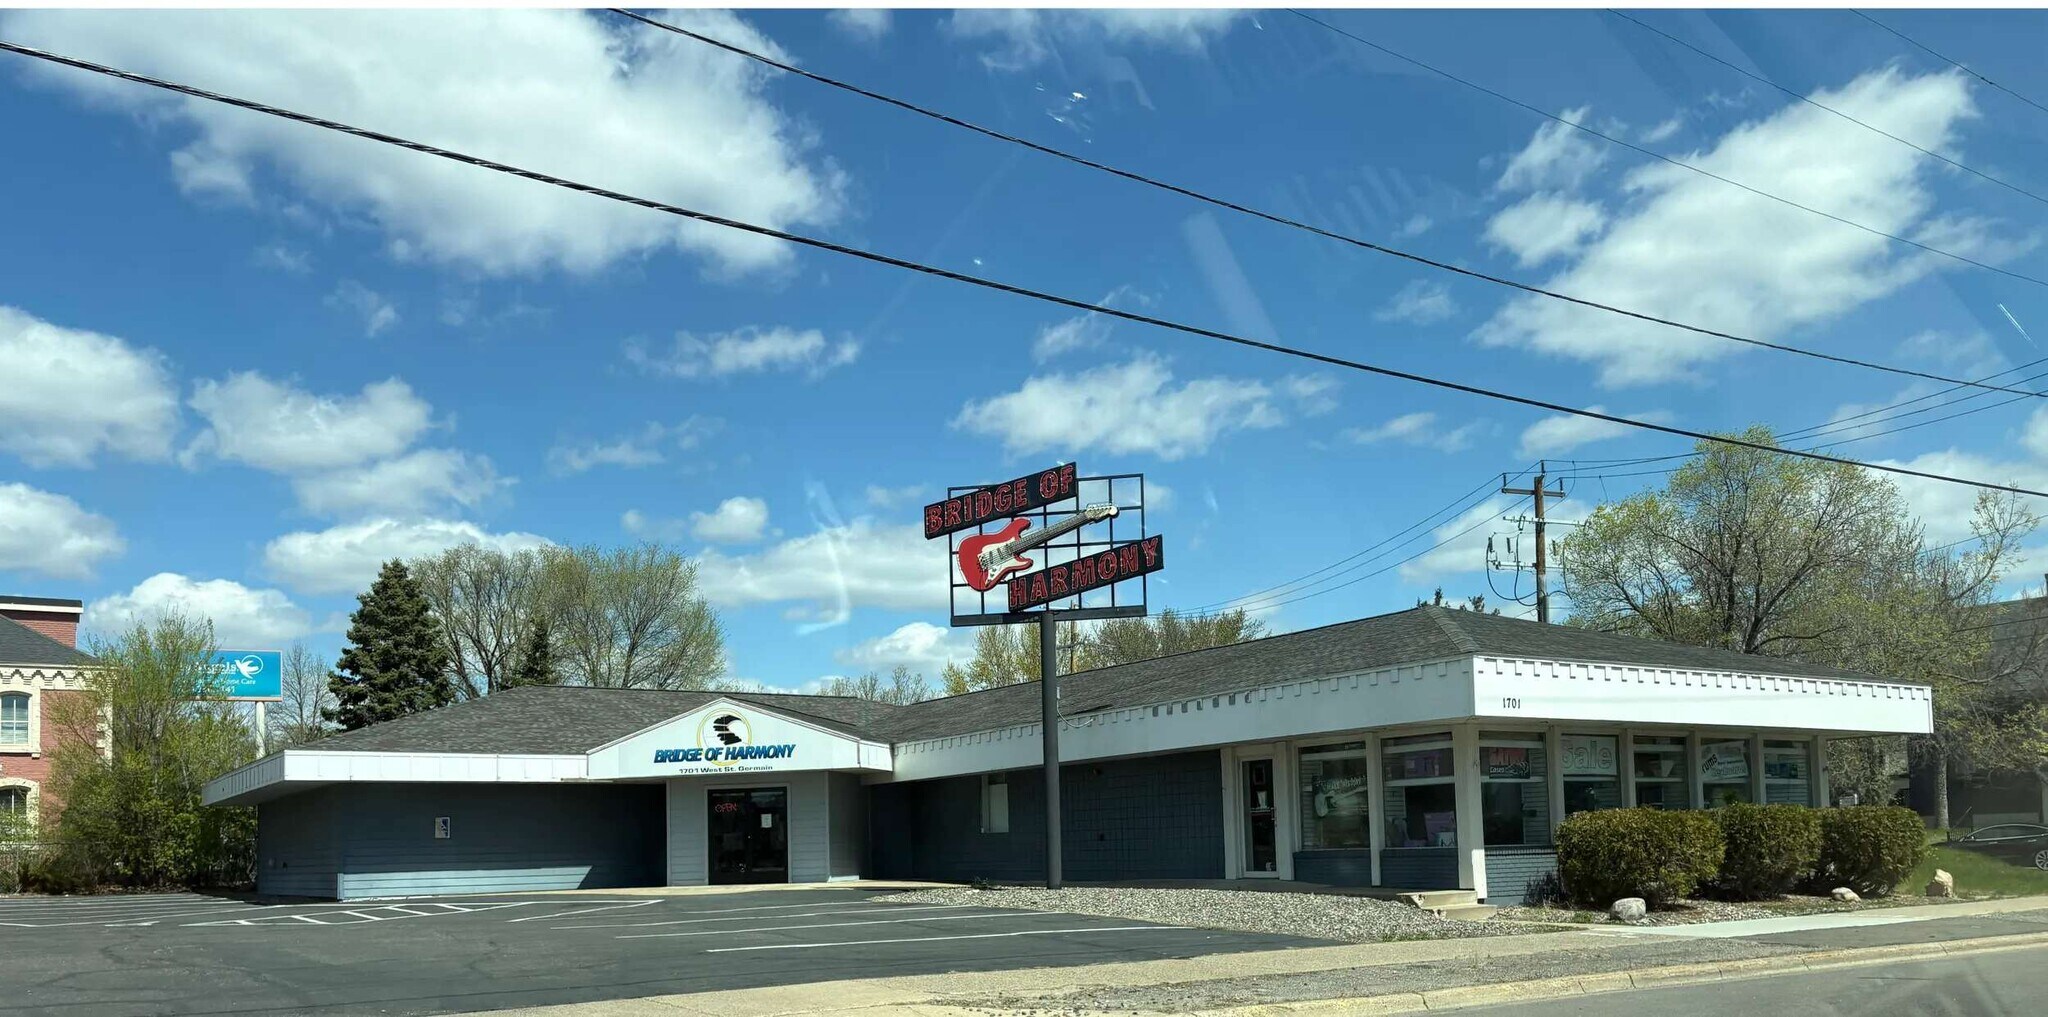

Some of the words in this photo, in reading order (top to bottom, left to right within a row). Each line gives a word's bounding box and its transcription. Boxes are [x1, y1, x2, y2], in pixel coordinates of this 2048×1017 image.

[925, 479, 1028, 534] BRIDGE
[1039, 464, 1074, 500] OF
[1009, 537, 1159, 607] HARMONY
[1503, 697, 1521, 709] 1701
[654, 749, 703, 763] BRIDGE
[705, 747, 723, 761] OF
[725, 744, 796, 761] HARMONY
[714, 802, 737, 813] OPEN
